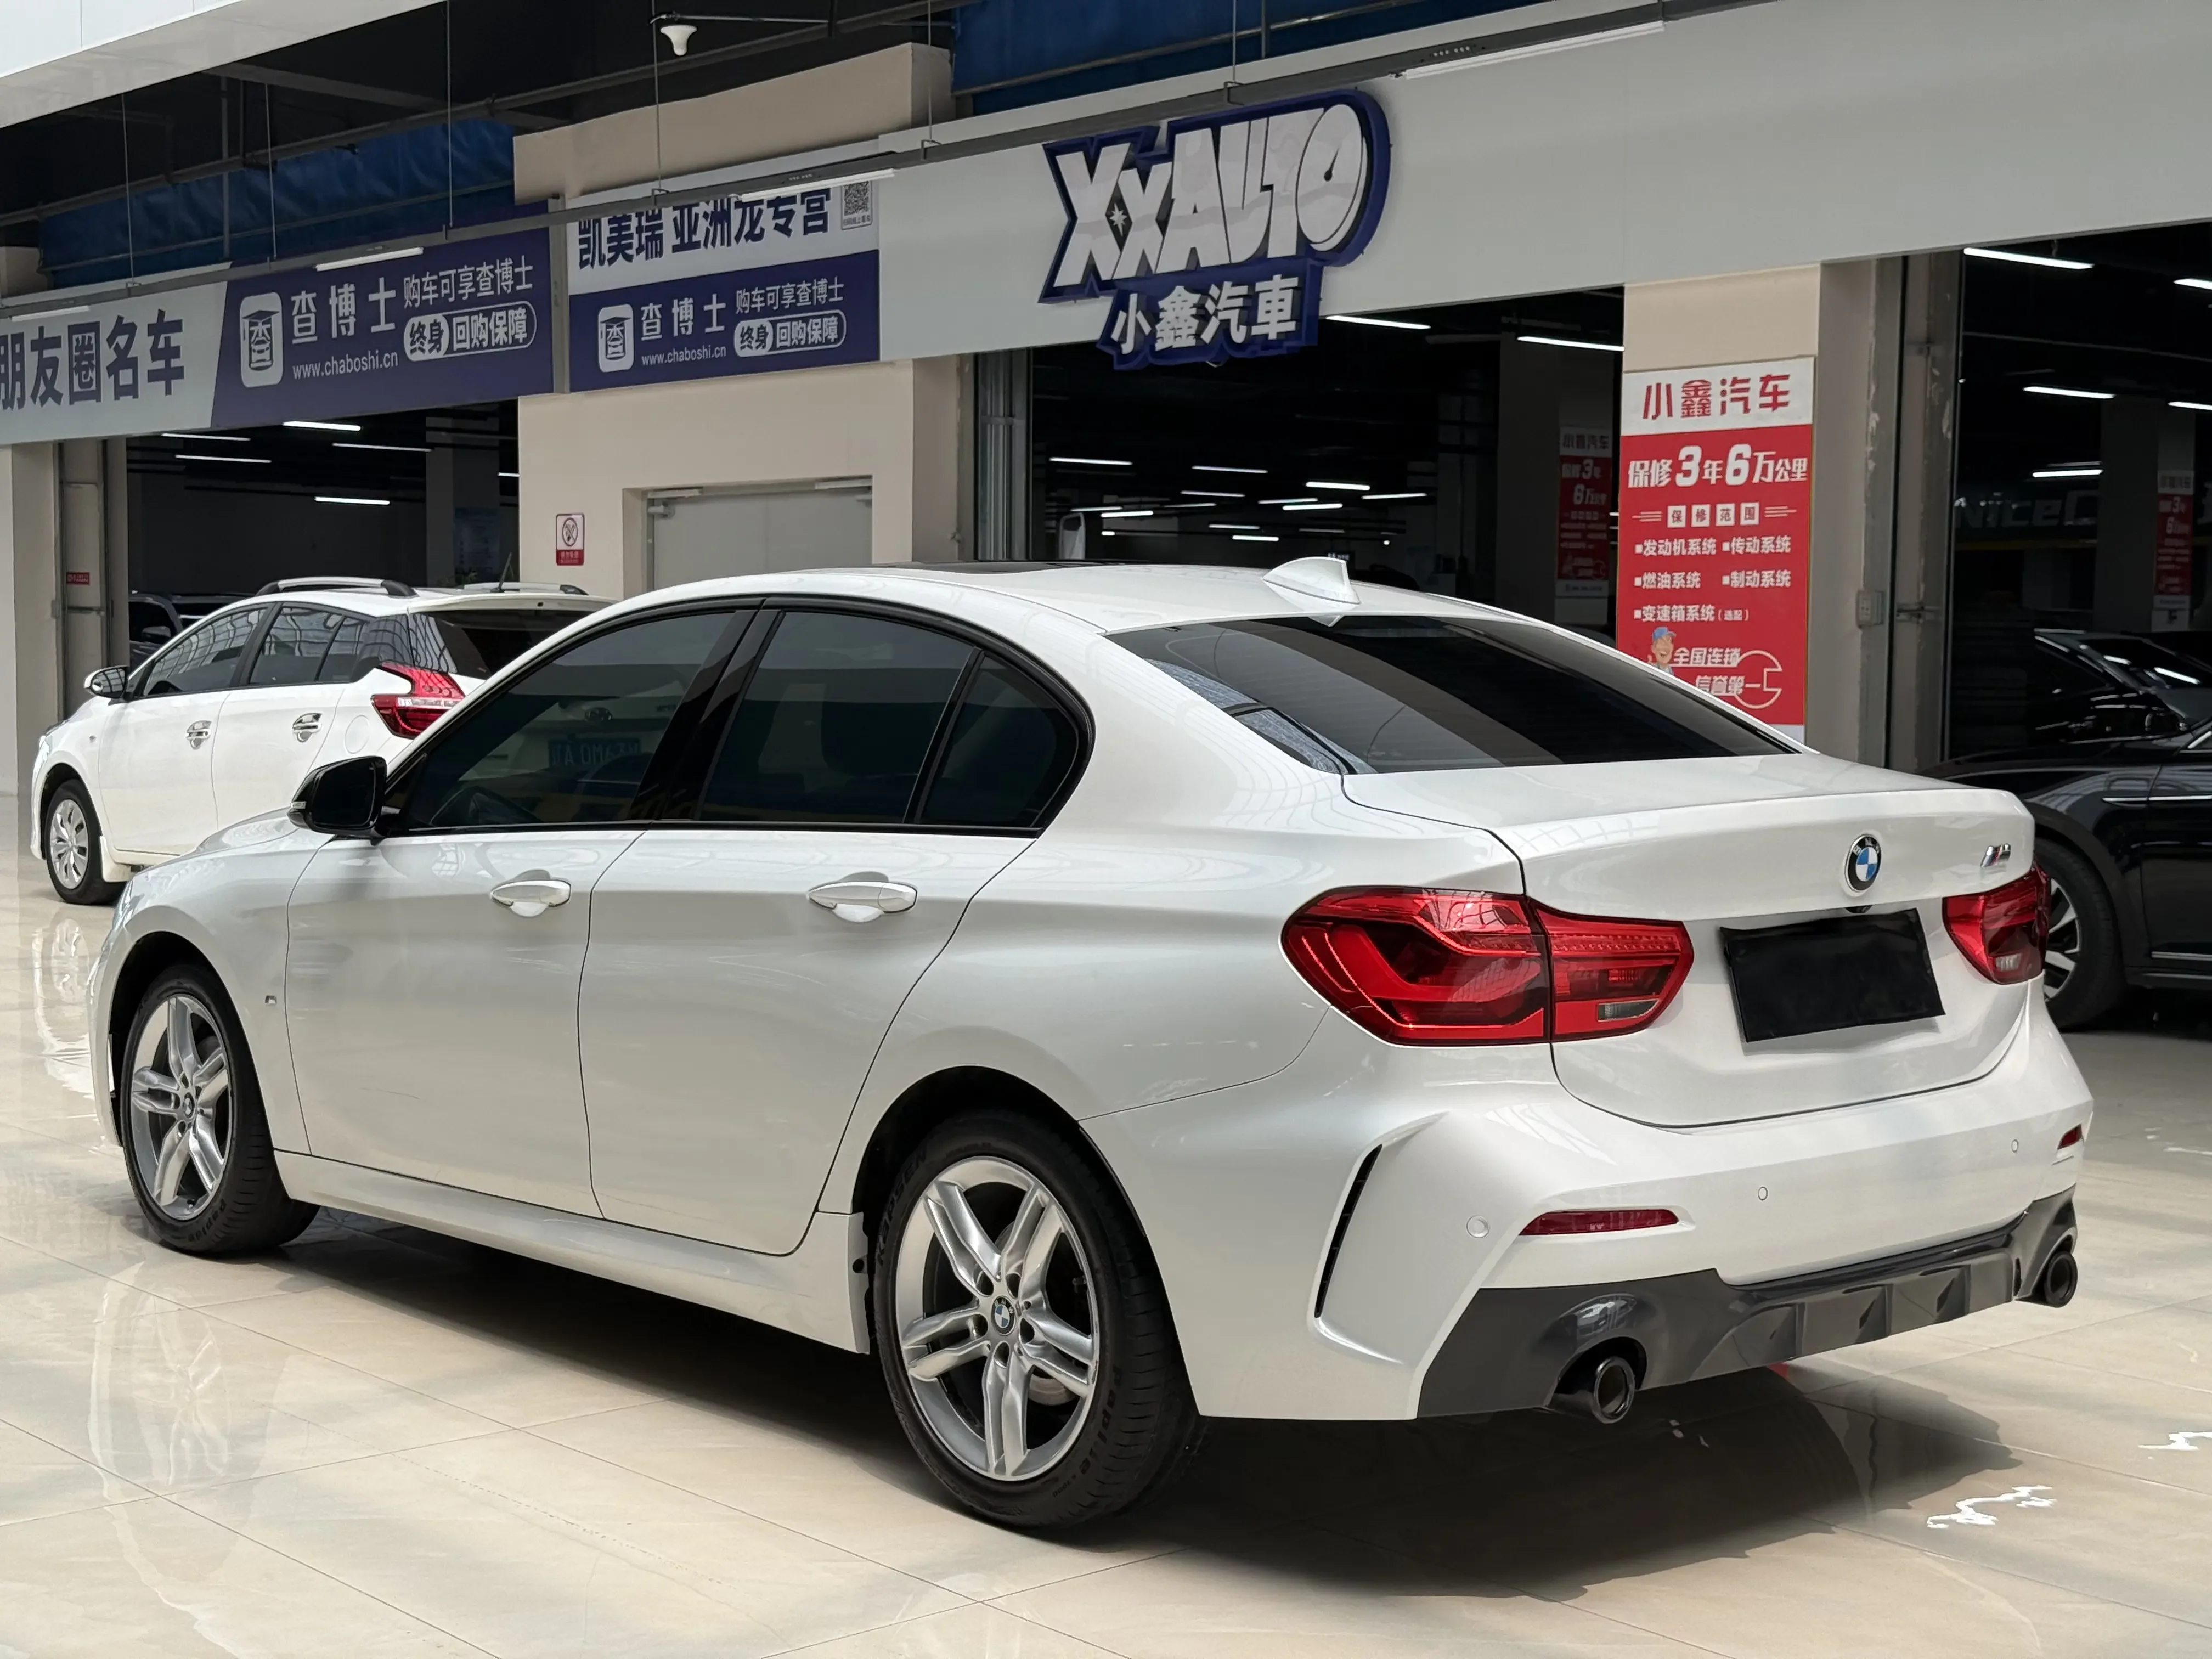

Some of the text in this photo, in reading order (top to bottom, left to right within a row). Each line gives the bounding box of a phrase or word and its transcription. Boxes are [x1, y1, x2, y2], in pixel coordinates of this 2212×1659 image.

[1053, 104, 1368, 287] XXAUTO
[404, 256, 533, 309] 购车可享查博士
[736, 276, 844, 313] 购车可享查博士
[291, 278, 396, 345] 查博士
[640, 294, 726, 341] 查博士
[1111, 275, 1299, 354] 小鑫汽車
[0, 308, 185, 411] 朋友圈名车
[292, 349, 399, 380] www.chaboshi.cn
[641, 346, 726, 366] www.chaboshi.cn
[1643, 374, 1790, 419] 小鑫汽车
